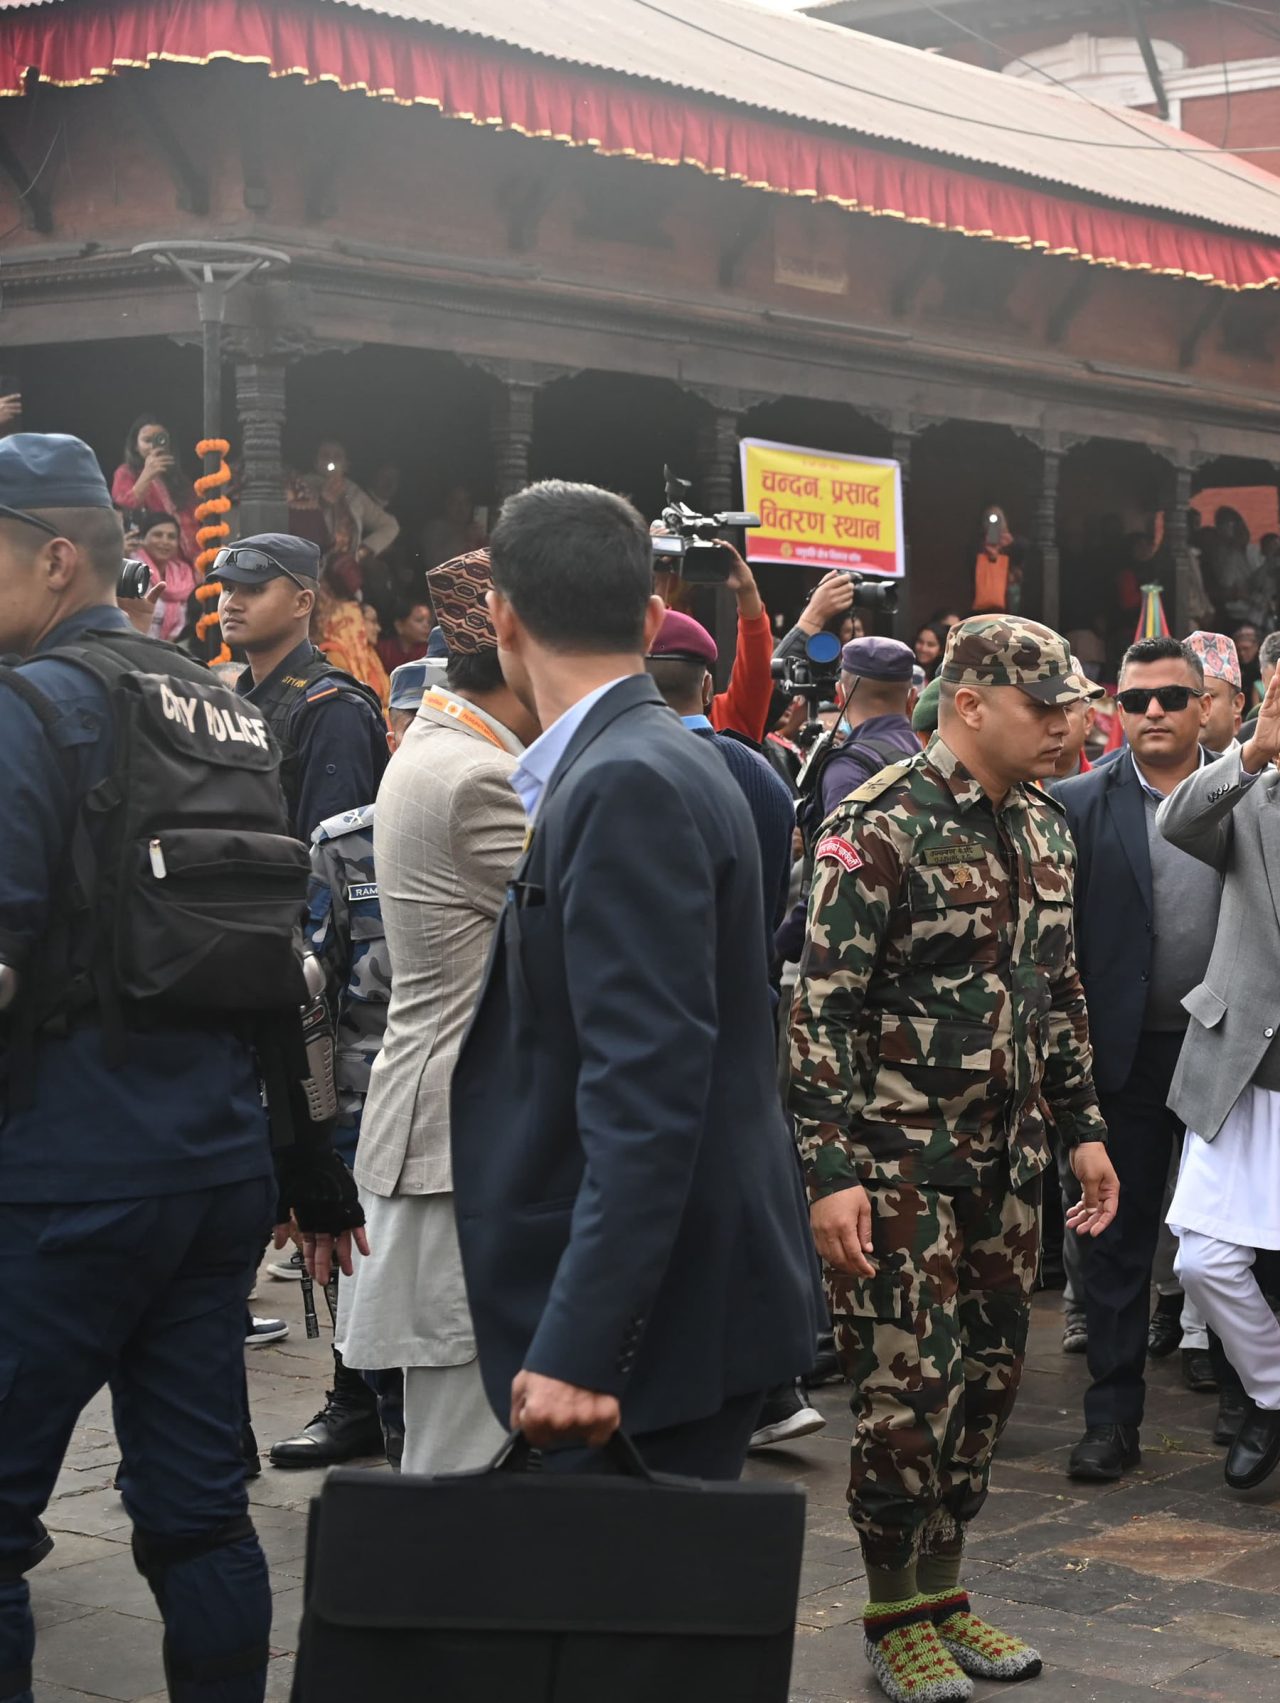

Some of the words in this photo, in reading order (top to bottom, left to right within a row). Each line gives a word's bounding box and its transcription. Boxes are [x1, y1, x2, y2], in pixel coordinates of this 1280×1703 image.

[831, 480, 881, 508] प्रसाद
[759, 498, 825, 534] वितरण
[832, 514, 881, 541] स्थान
